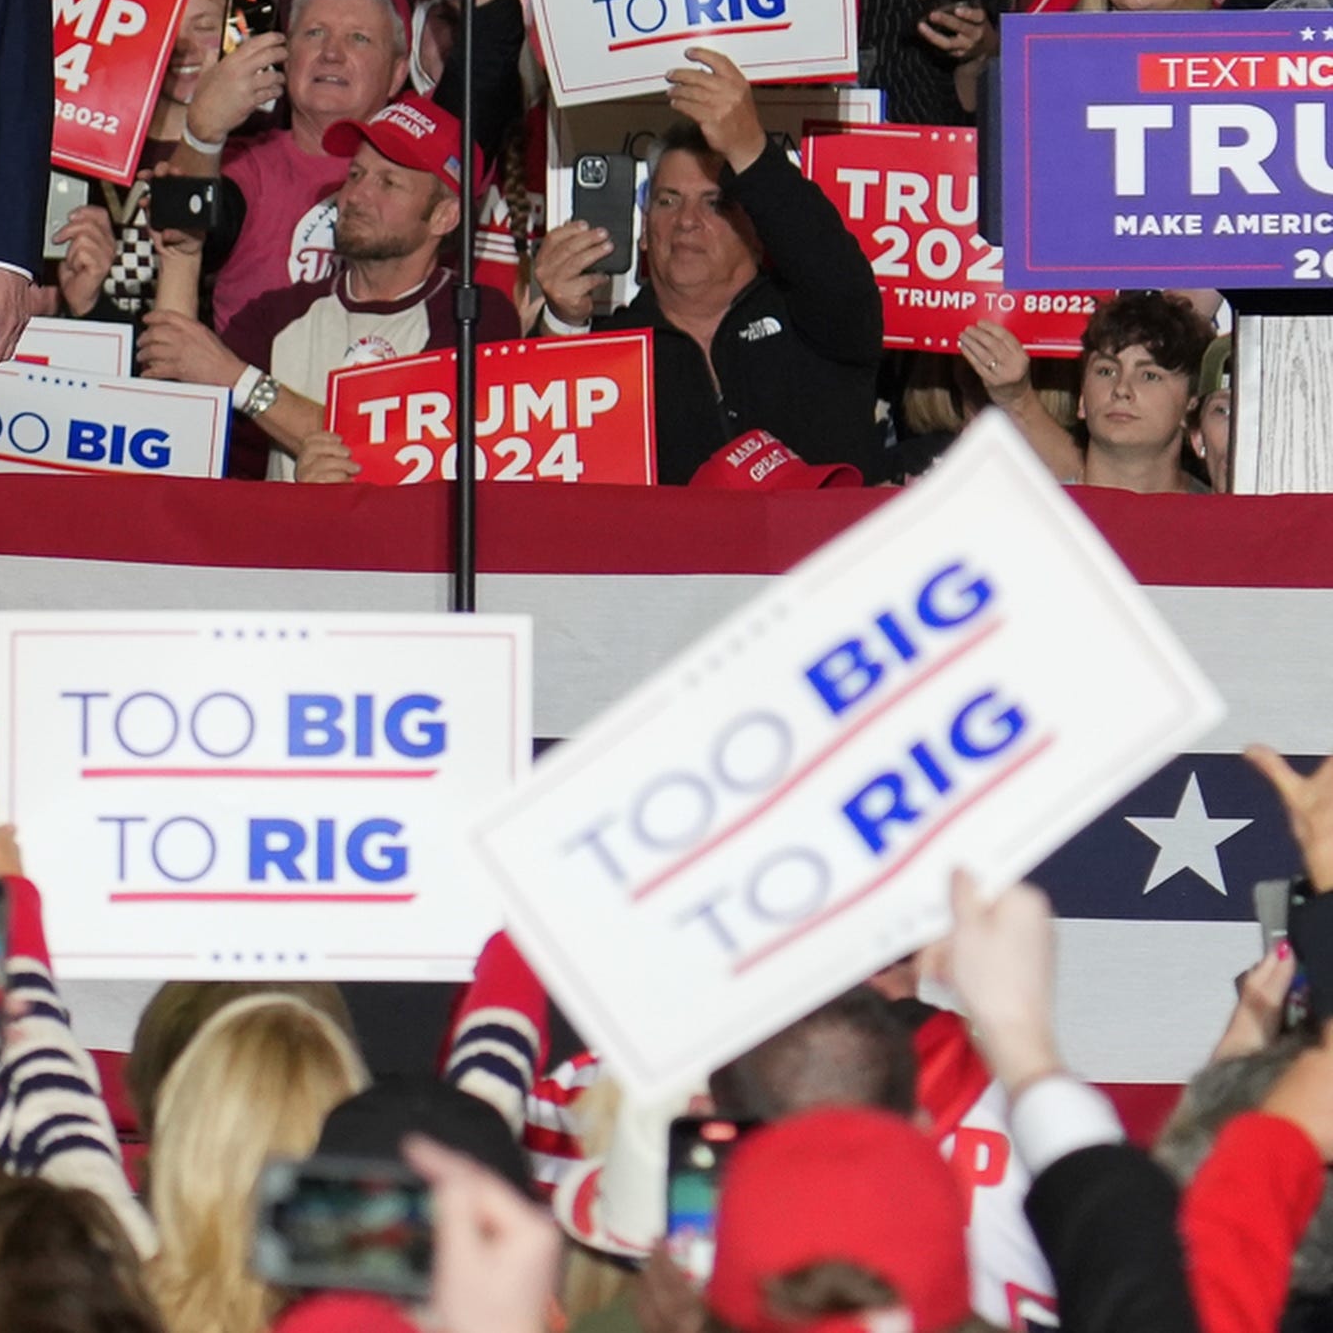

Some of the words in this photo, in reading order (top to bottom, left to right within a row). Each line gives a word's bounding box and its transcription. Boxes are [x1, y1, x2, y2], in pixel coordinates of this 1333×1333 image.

[1159, 57, 1266, 88] TEXT
[1114, 215, 1203, 235] MAKE
[895, 287, 976, 310] TRUMP
[984, 291, 1016, 312] TO
[1023, 295, 1096, 314] 88022
[358, 377, 621, 446] TRUMP
[67, 419, 172, 469] BIG
[394, 433, 584, 483] 2024
[726, 438, 763, 467] MAKE
[60, 691, 255, 758] TOO
[287, 693, 448, 759] BIG
[562, 709, 794, 887] TOO
[804, 557, 998, 718] BIG
[678, 846, 832, 955] TO
[841, 686, 1028, 857] RIG
[97, 816, 217, 882] TO
[247, 817, 409, 883] RIG
